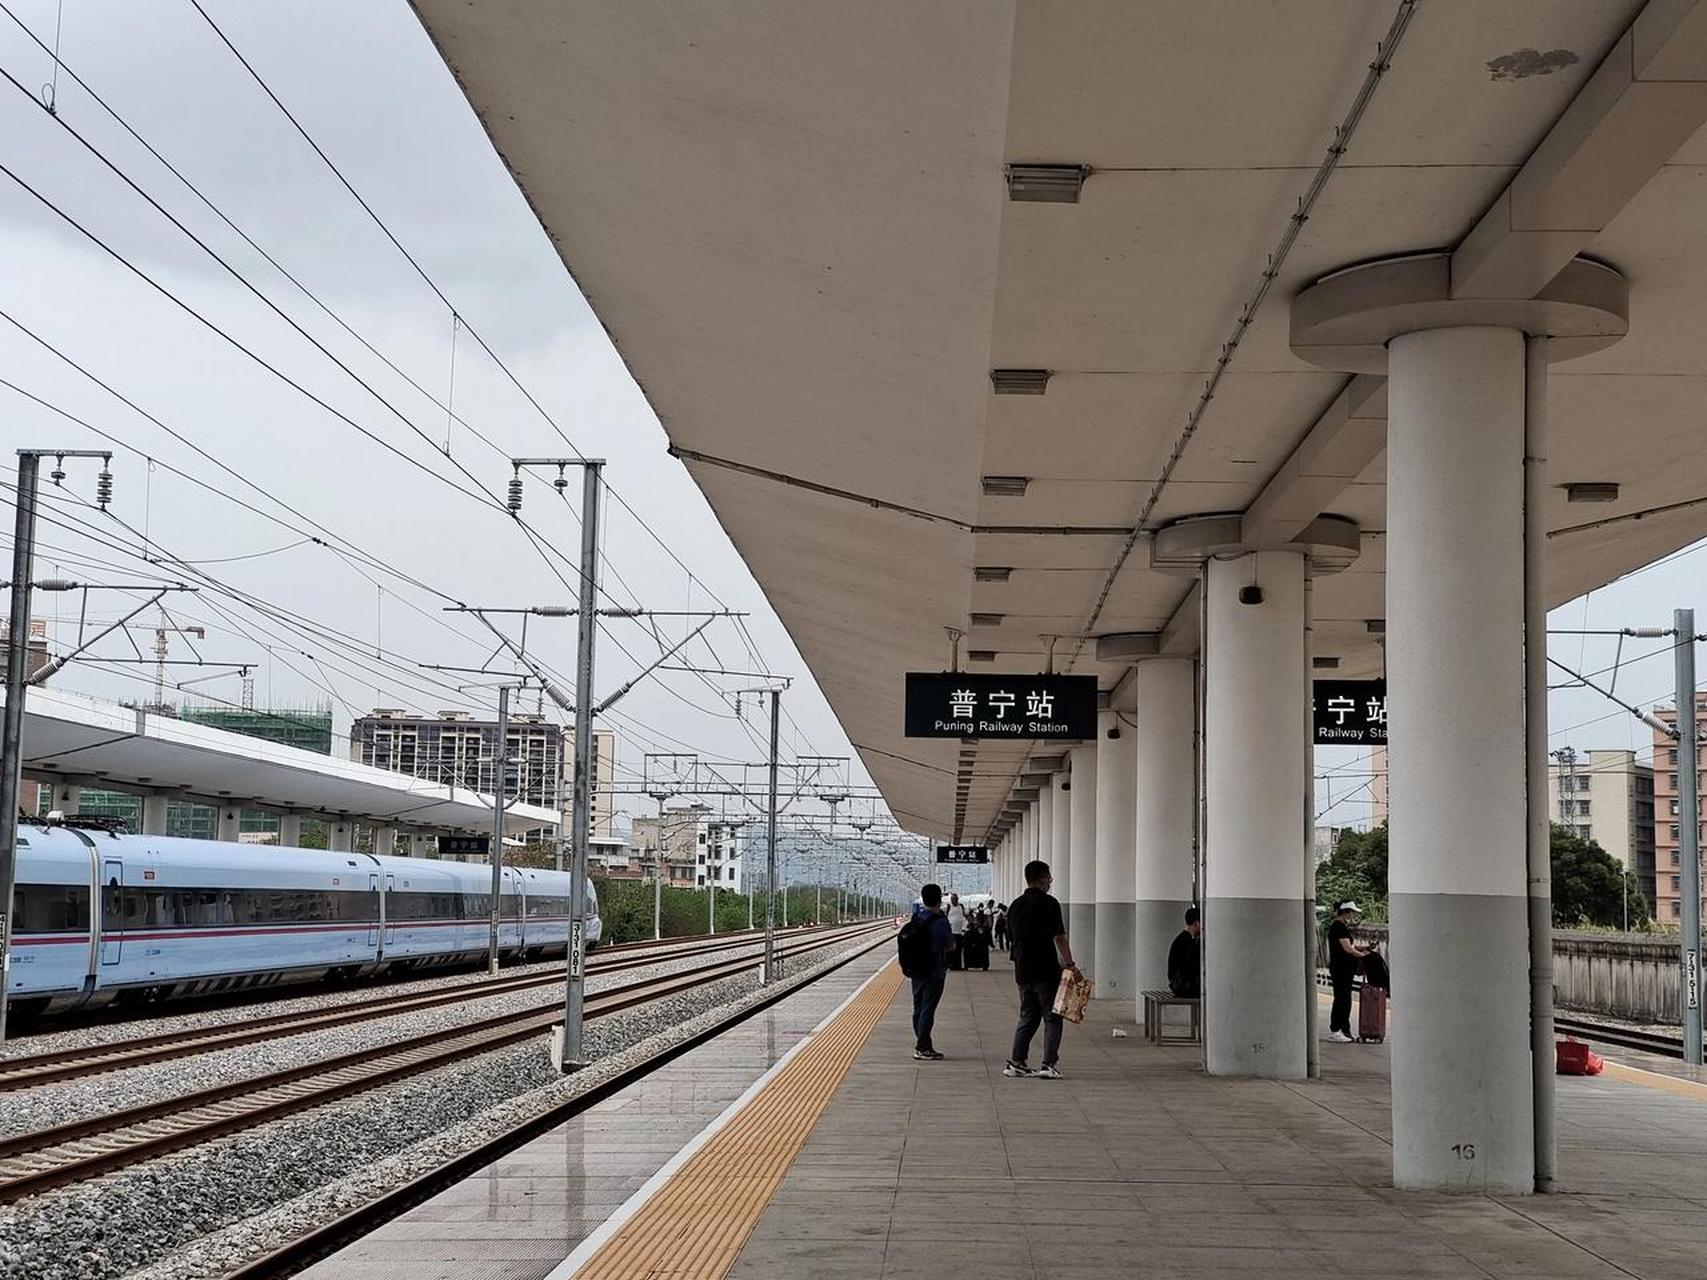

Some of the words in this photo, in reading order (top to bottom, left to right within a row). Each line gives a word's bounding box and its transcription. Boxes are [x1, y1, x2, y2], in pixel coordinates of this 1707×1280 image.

[949, 689, 1055, 719] 普宁站
[1312, 695, 1388, 725] 宁站
[934, 720, 974, 734] Puning
[979, 721, 1024, 734] Railway
[1028, 722, 1068, 733] Station
[1318, 727, 1364, 740] Railway
[1451, 1143, 1475, 1160] 16
